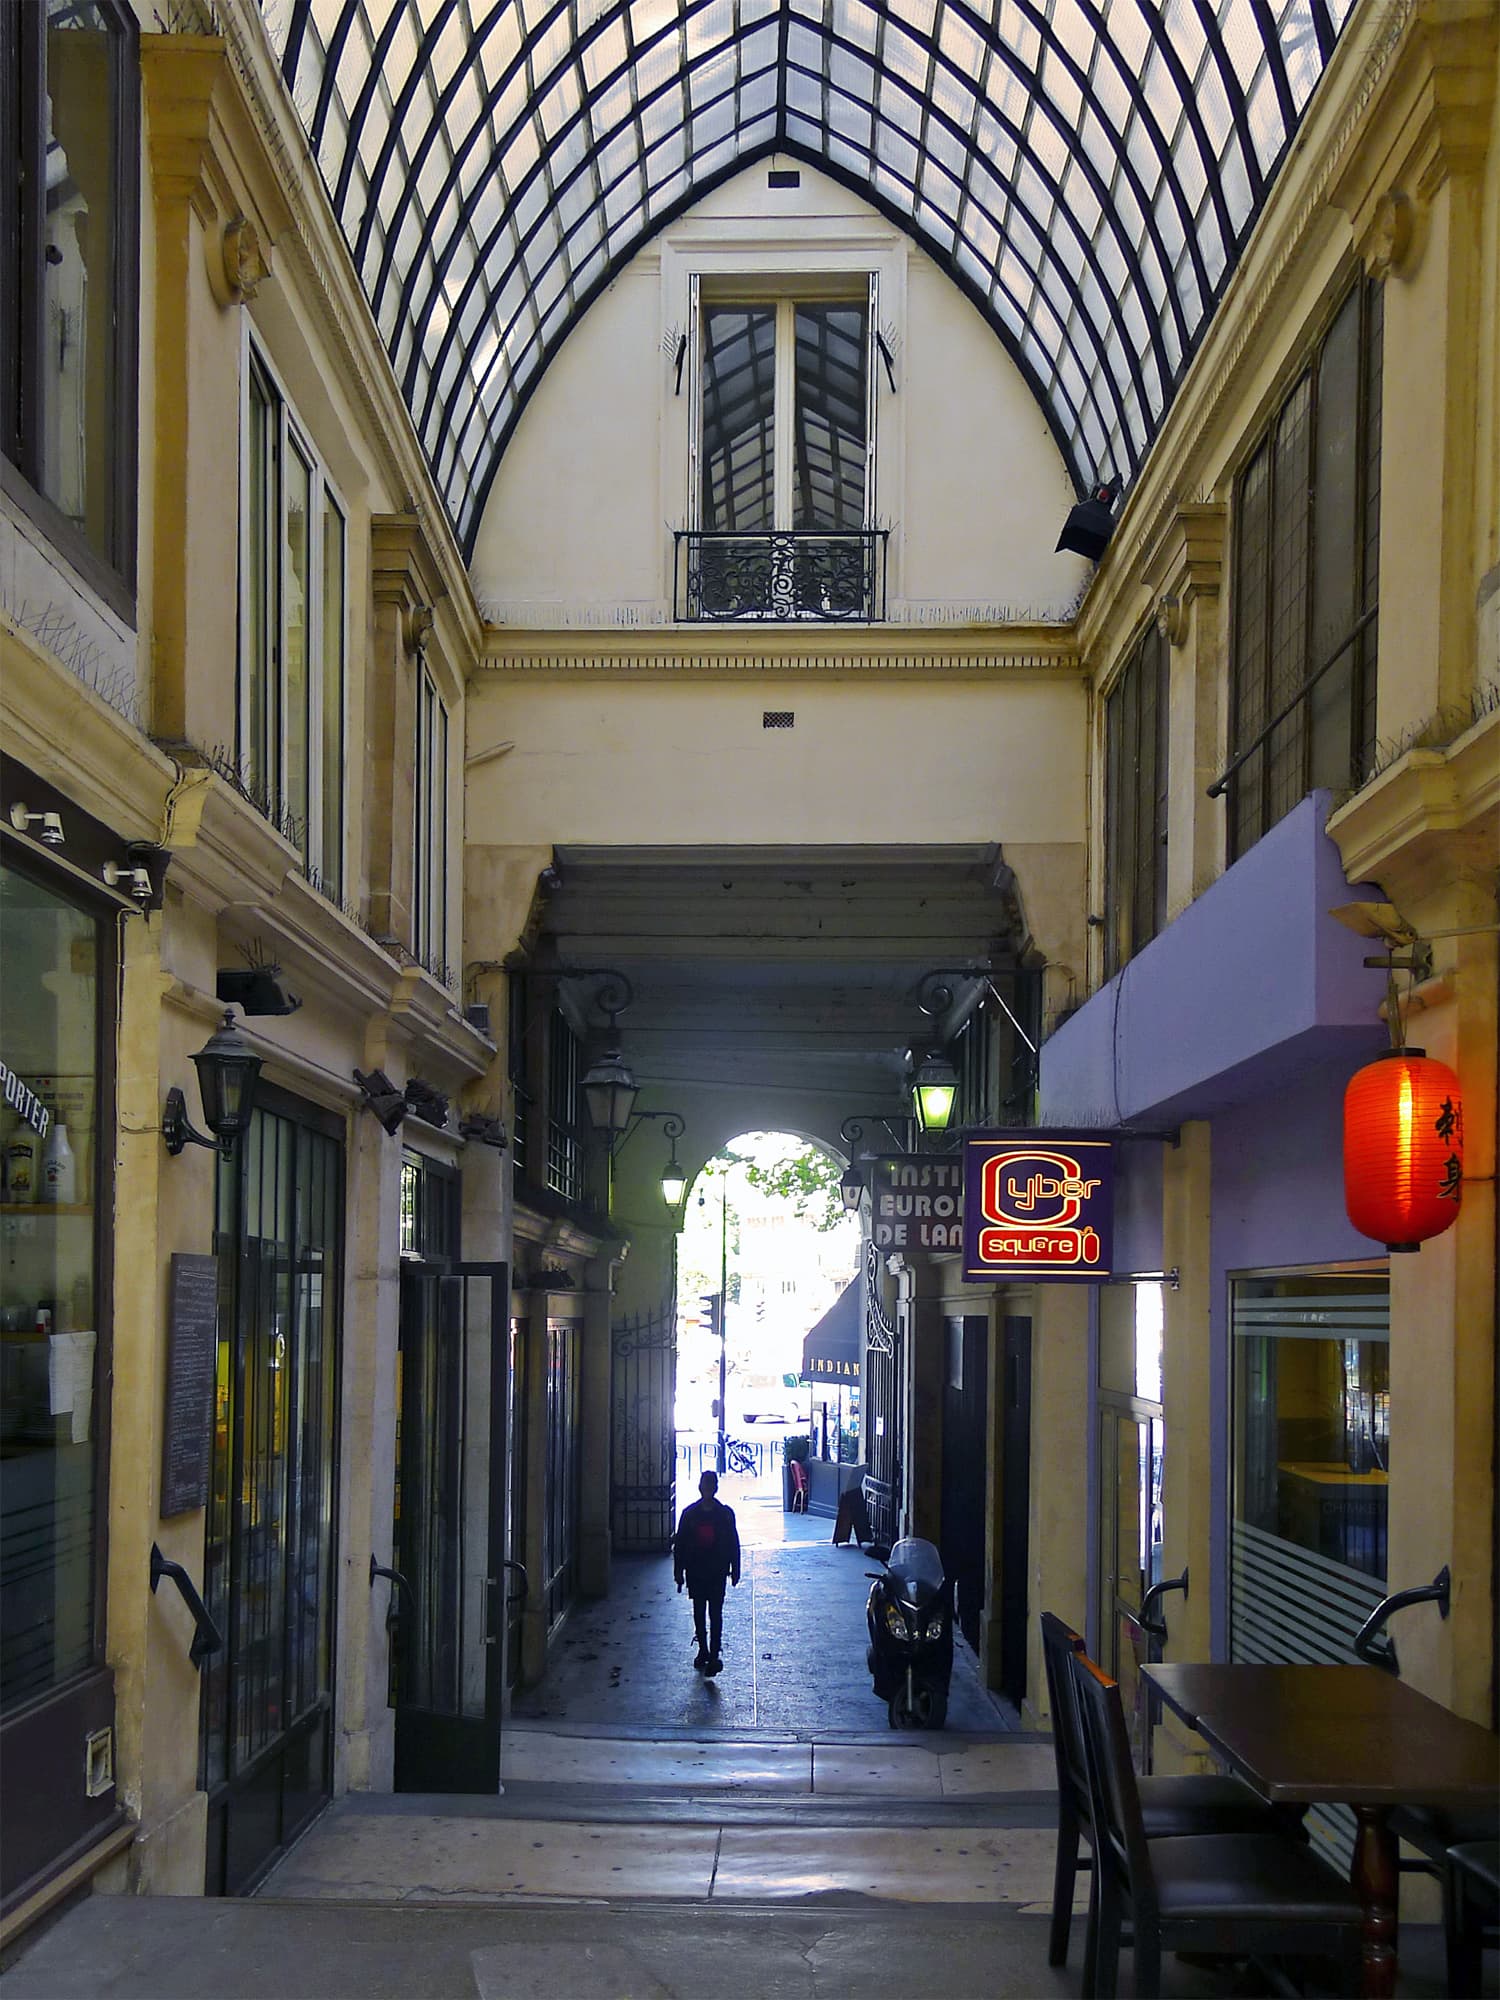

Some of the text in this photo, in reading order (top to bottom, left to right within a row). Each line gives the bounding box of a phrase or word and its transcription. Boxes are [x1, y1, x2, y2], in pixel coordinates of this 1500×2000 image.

[891, 1165, 960, 1187] INSTI
[981, 1150, 1102, 1228] Cyber
[876, 1223, 907, 1246] DE
